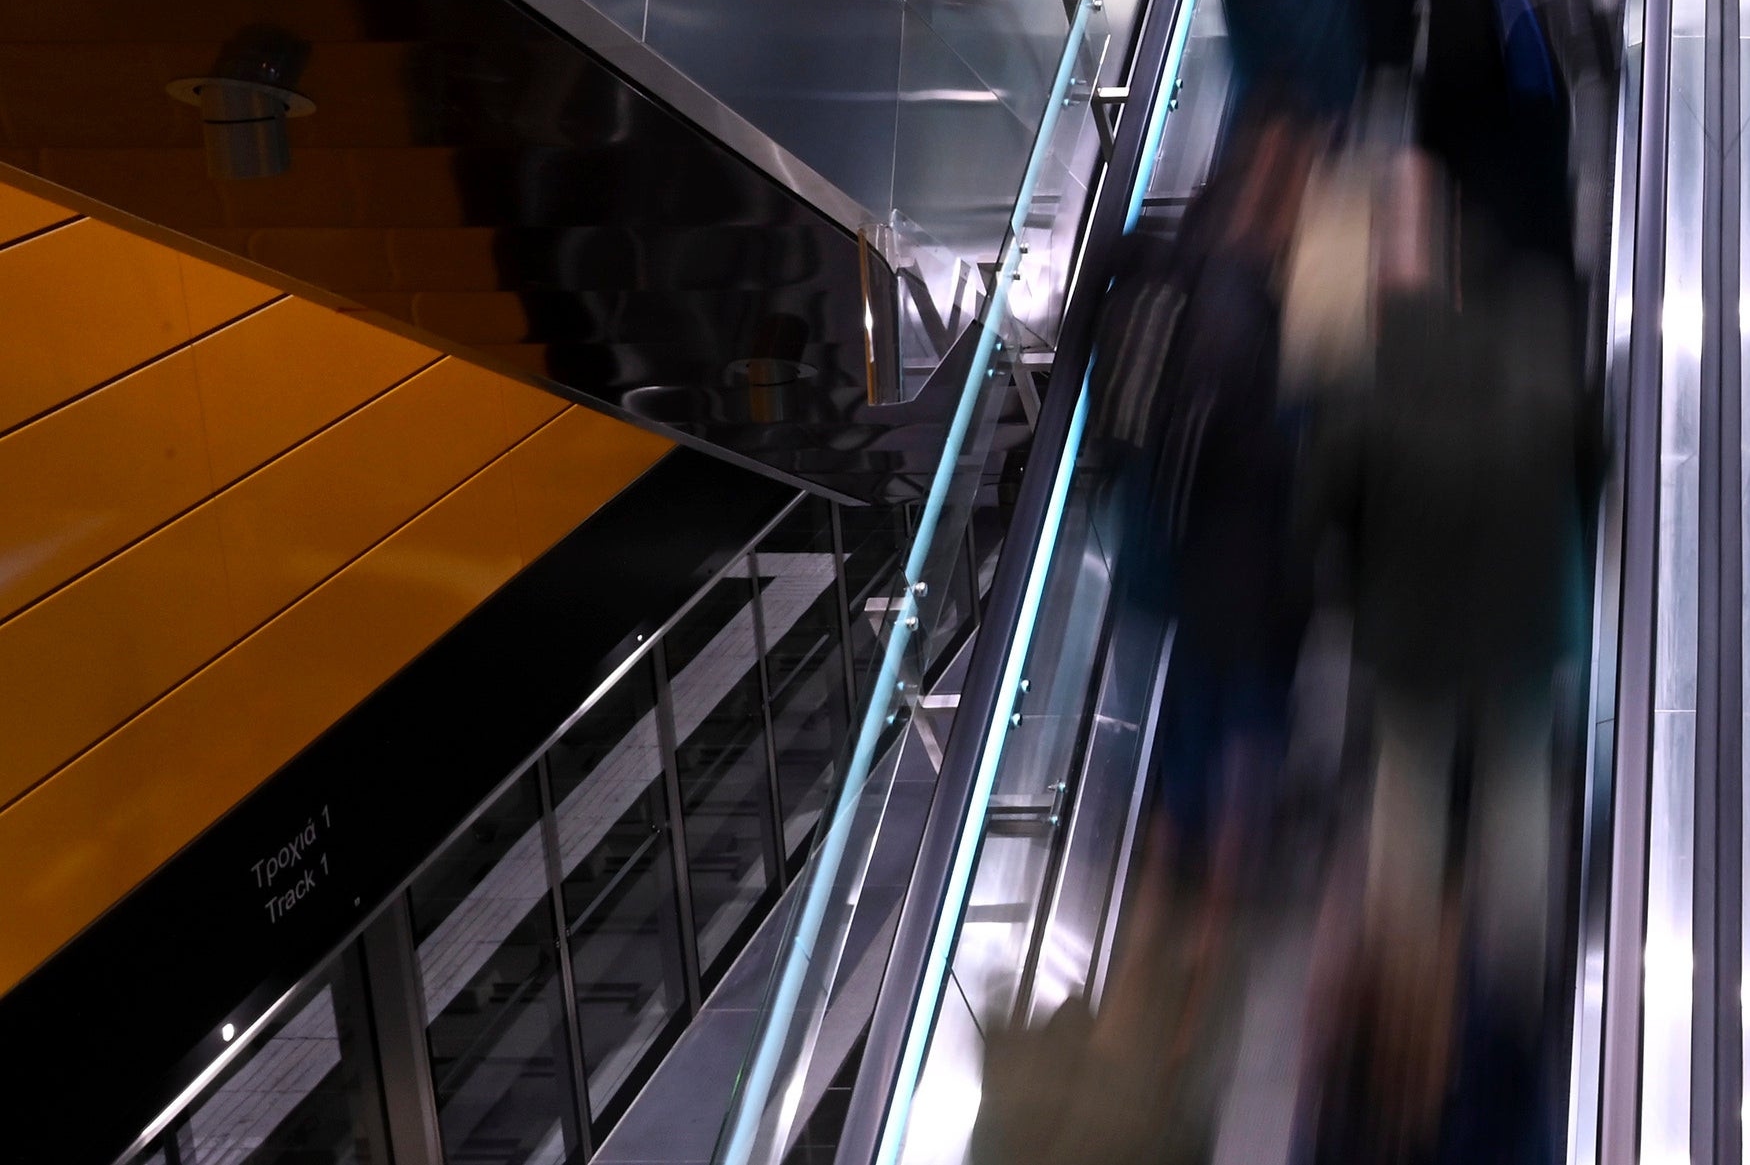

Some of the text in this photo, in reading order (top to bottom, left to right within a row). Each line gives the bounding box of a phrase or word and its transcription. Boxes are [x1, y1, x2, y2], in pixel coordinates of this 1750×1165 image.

[250, 804, 331, 889] Τροχιά 1
[264, 852, 329, 924] Track 1
